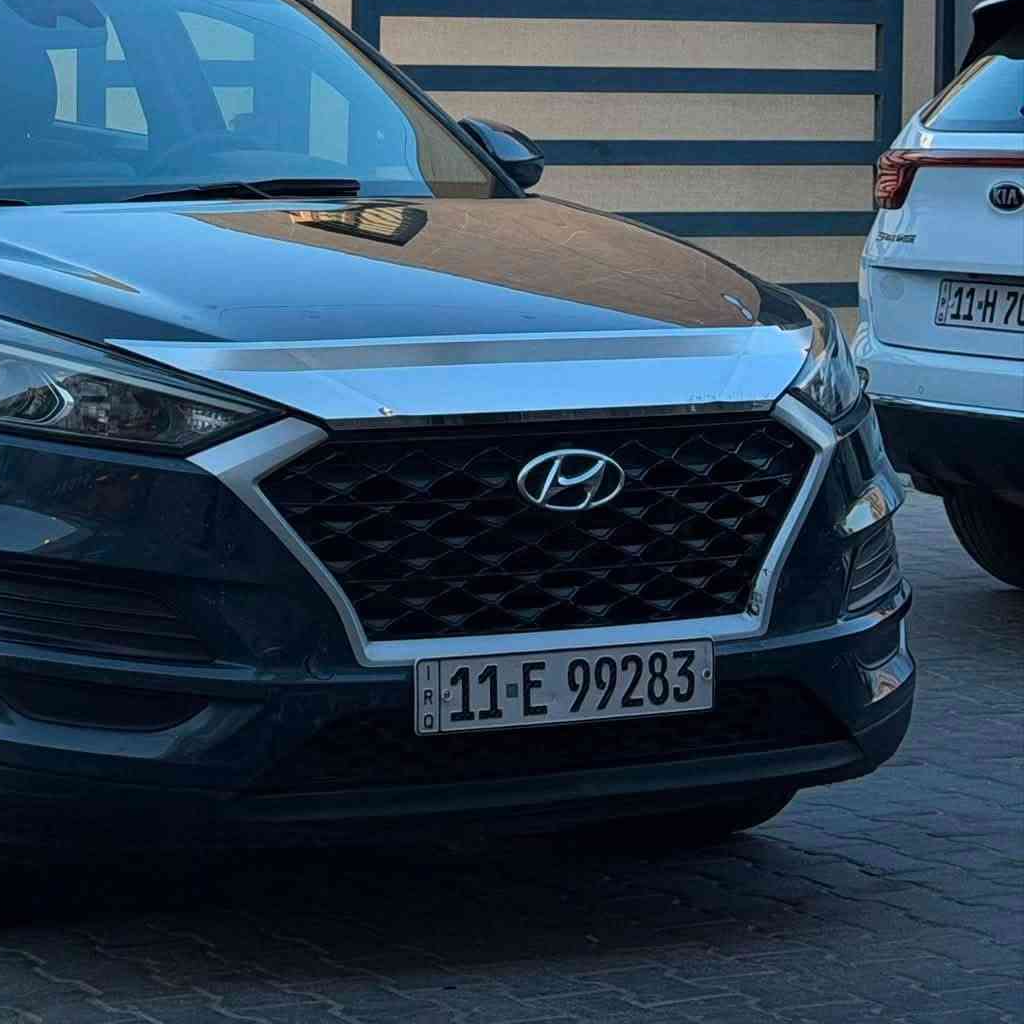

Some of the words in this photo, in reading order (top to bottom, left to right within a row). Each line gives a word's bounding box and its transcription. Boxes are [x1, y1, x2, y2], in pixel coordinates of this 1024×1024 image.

[992, 187, 1020, 206] KIA
[950, 287, 976, 321] 11
[982, 288, 998, 323] H
[450, 664, 503, 721] 11
[522, 661, 548, 717] E
[567, 649, 696, 713] 99283
